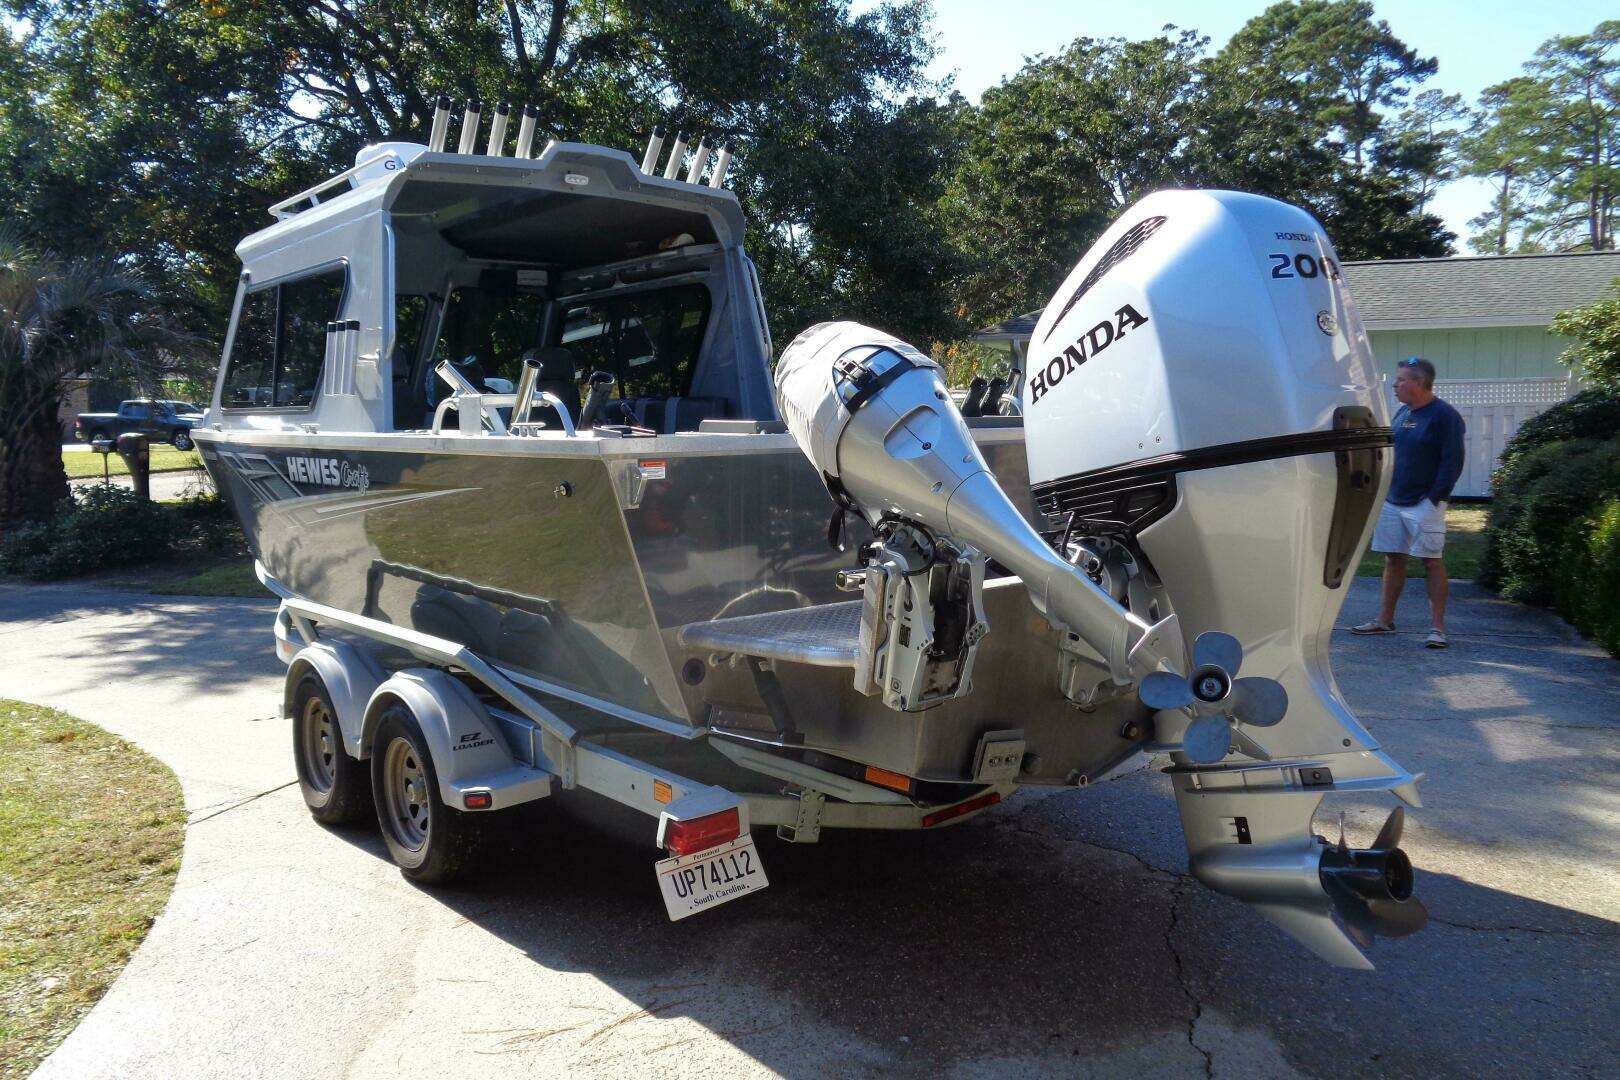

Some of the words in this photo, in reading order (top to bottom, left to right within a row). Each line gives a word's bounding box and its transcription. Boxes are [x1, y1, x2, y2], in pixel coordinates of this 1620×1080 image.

[1268, 253, 1339, 280] 200
[1030, 303, 1148, 405] HONDA
[286, 456, 341, 486] HEWES
[452, 738, 496, 751] LOADER
[460, 732, 482, 743] EZ
[671, 850, 756, 898] UP74112
[693, 893, 715, 906] South
[715, 884, 746, 898] Carolina
